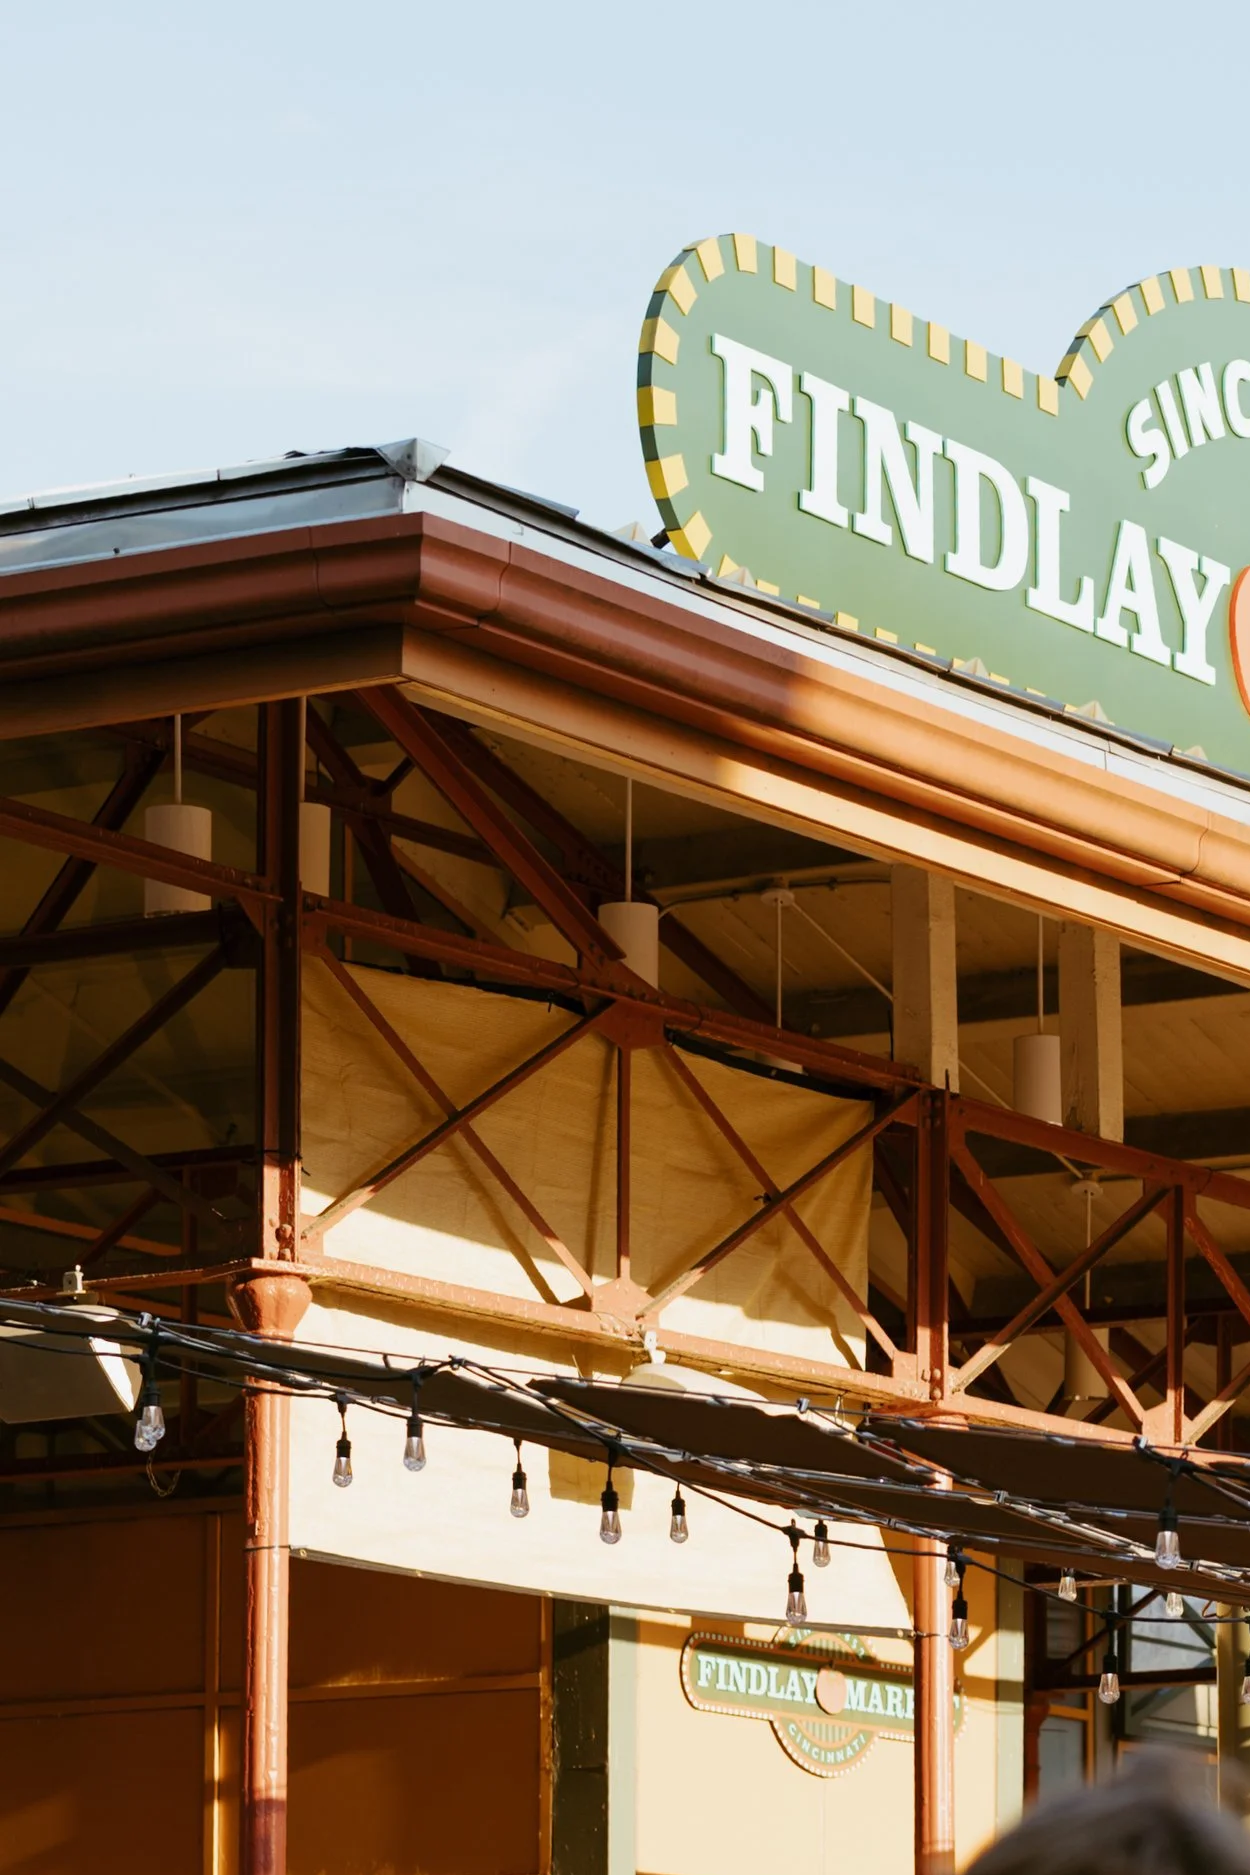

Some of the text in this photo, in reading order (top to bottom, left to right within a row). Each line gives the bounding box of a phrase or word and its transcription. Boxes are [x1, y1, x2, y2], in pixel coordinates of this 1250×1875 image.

[710, 332, 1231, 686] FINDLAY
[697, 1654, 818, 1705] FINDLAY
[788, 1723, 867, 1764] CINCINNATI
